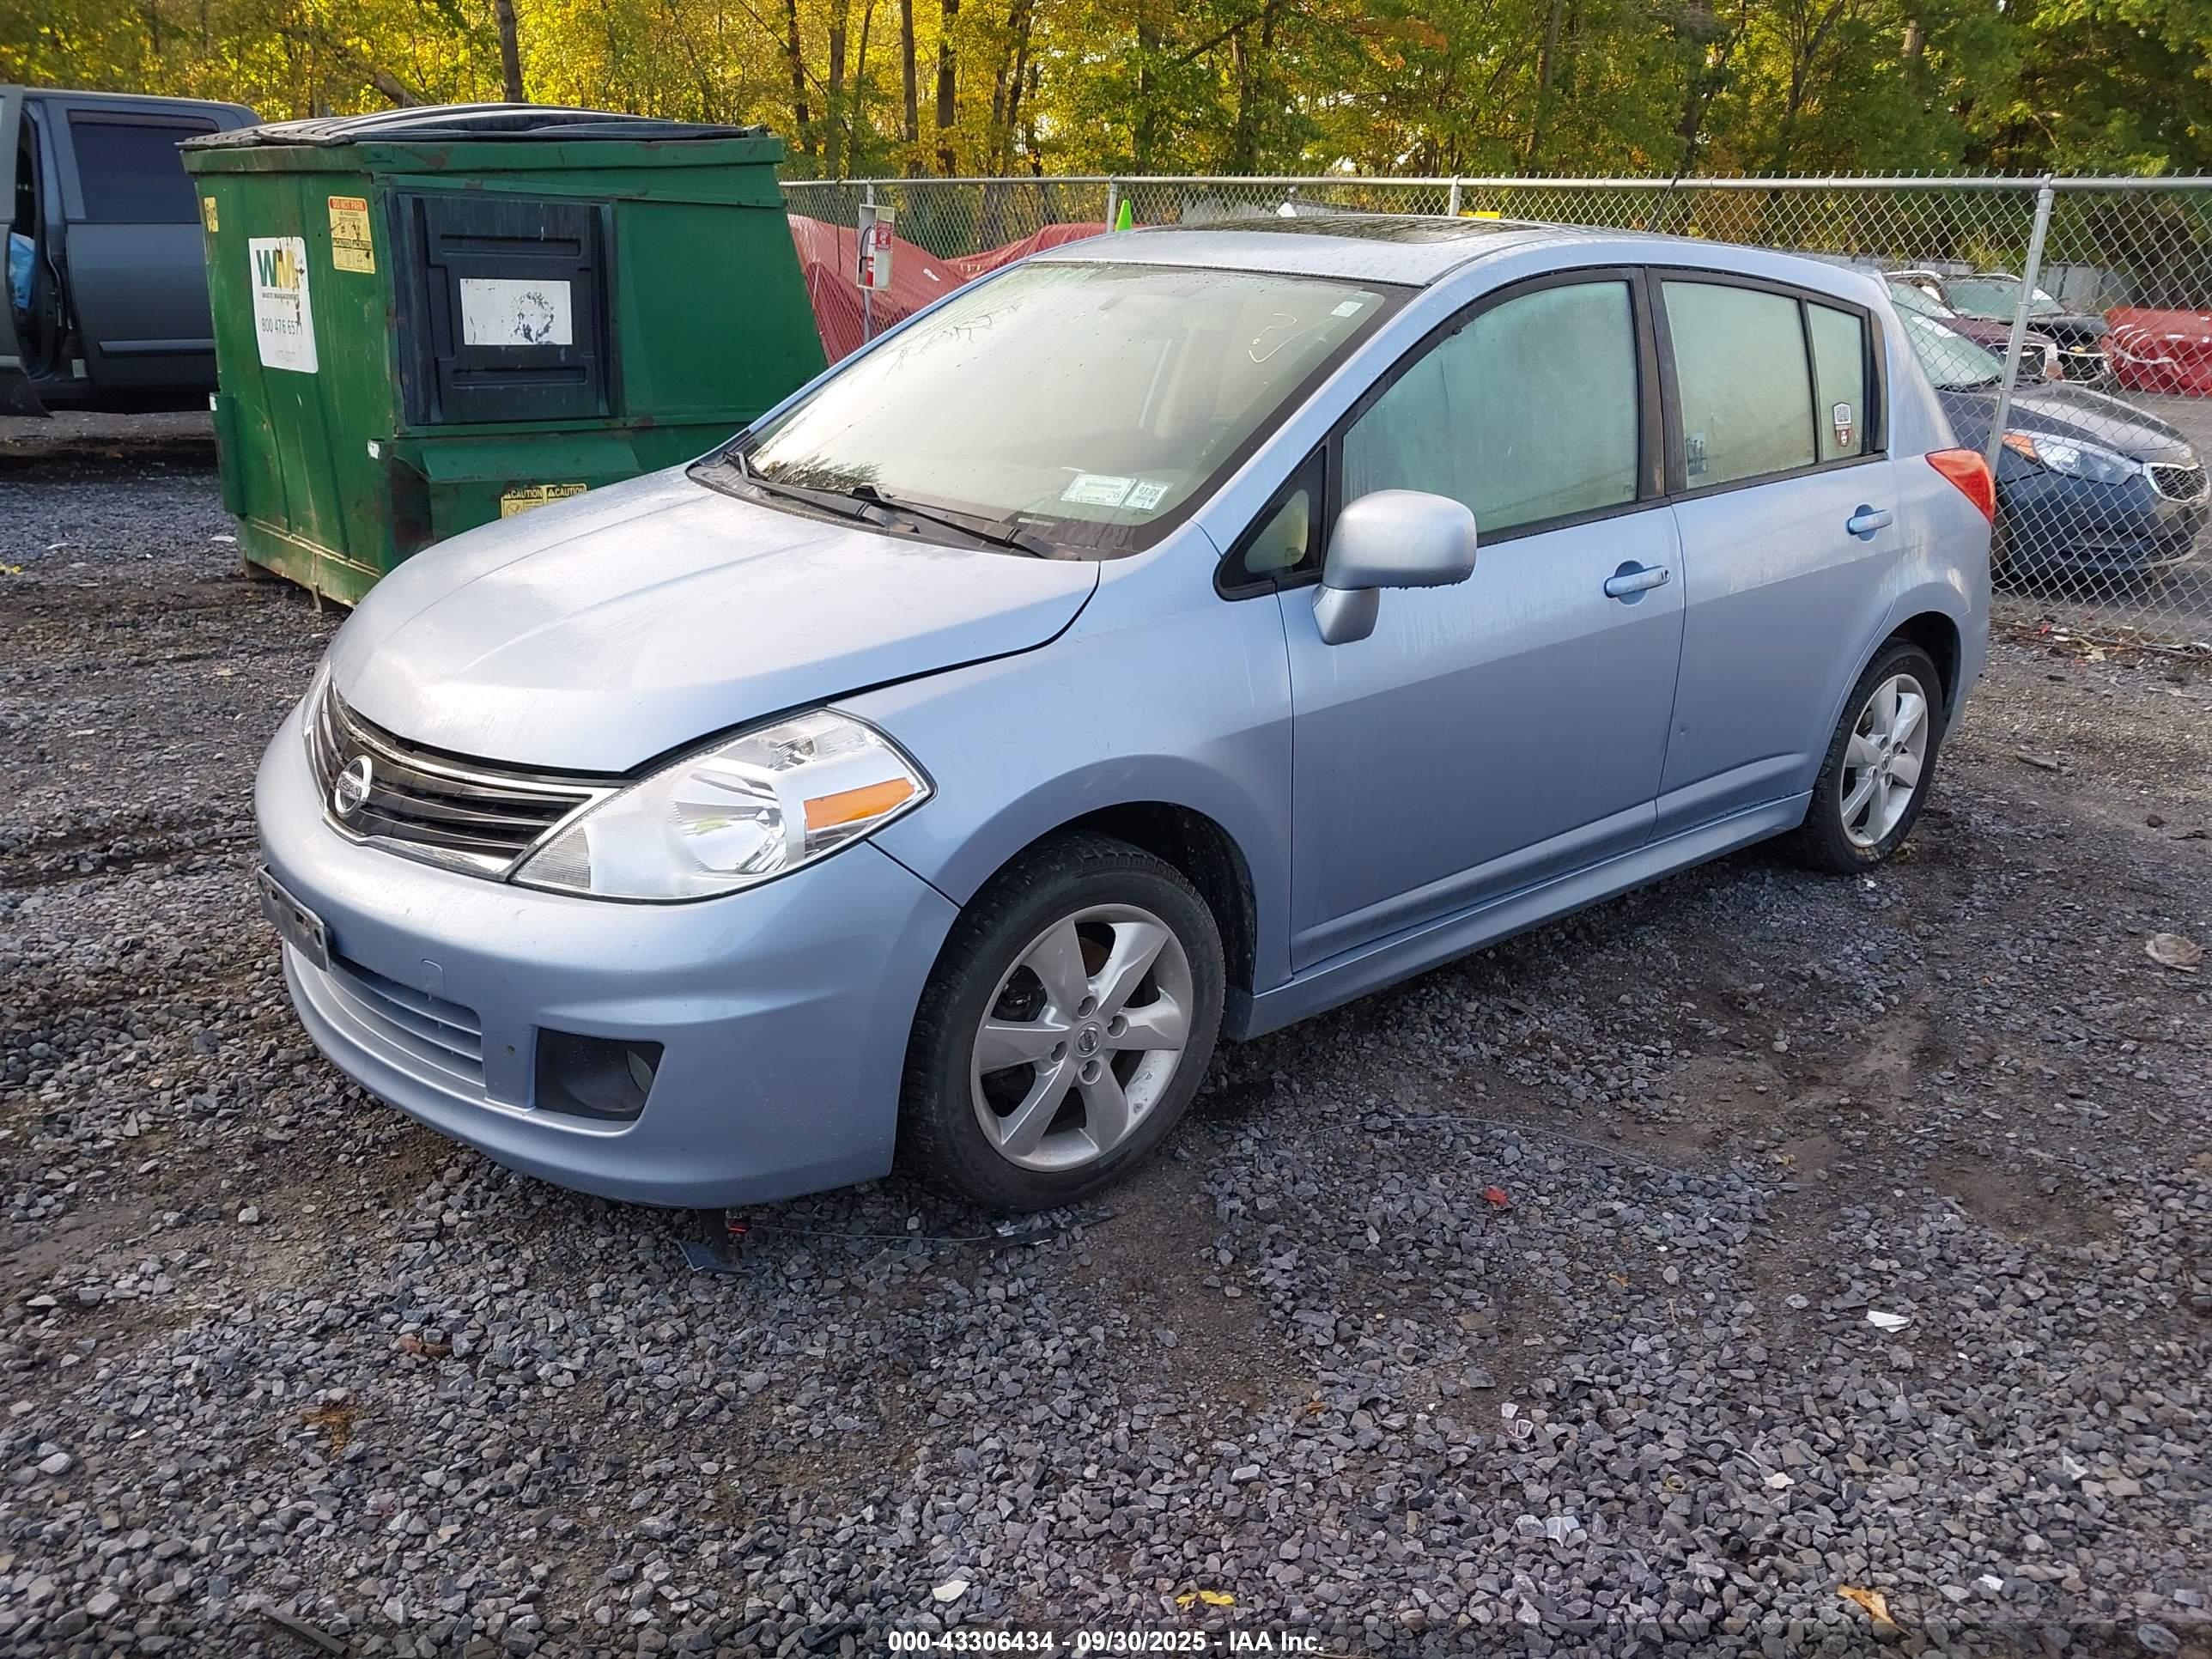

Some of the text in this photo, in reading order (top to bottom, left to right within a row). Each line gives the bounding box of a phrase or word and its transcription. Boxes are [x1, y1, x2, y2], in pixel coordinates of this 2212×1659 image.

[331, 198, 365, 210] DO NOT PARK
[256, 249, 298, 288] WM
[261, 318, 274, 332] 800
[275, 319, 287, 334] 476
[511, 489, 543, 498] CAUTION
[555, 487, 585, 496] CAUTION
